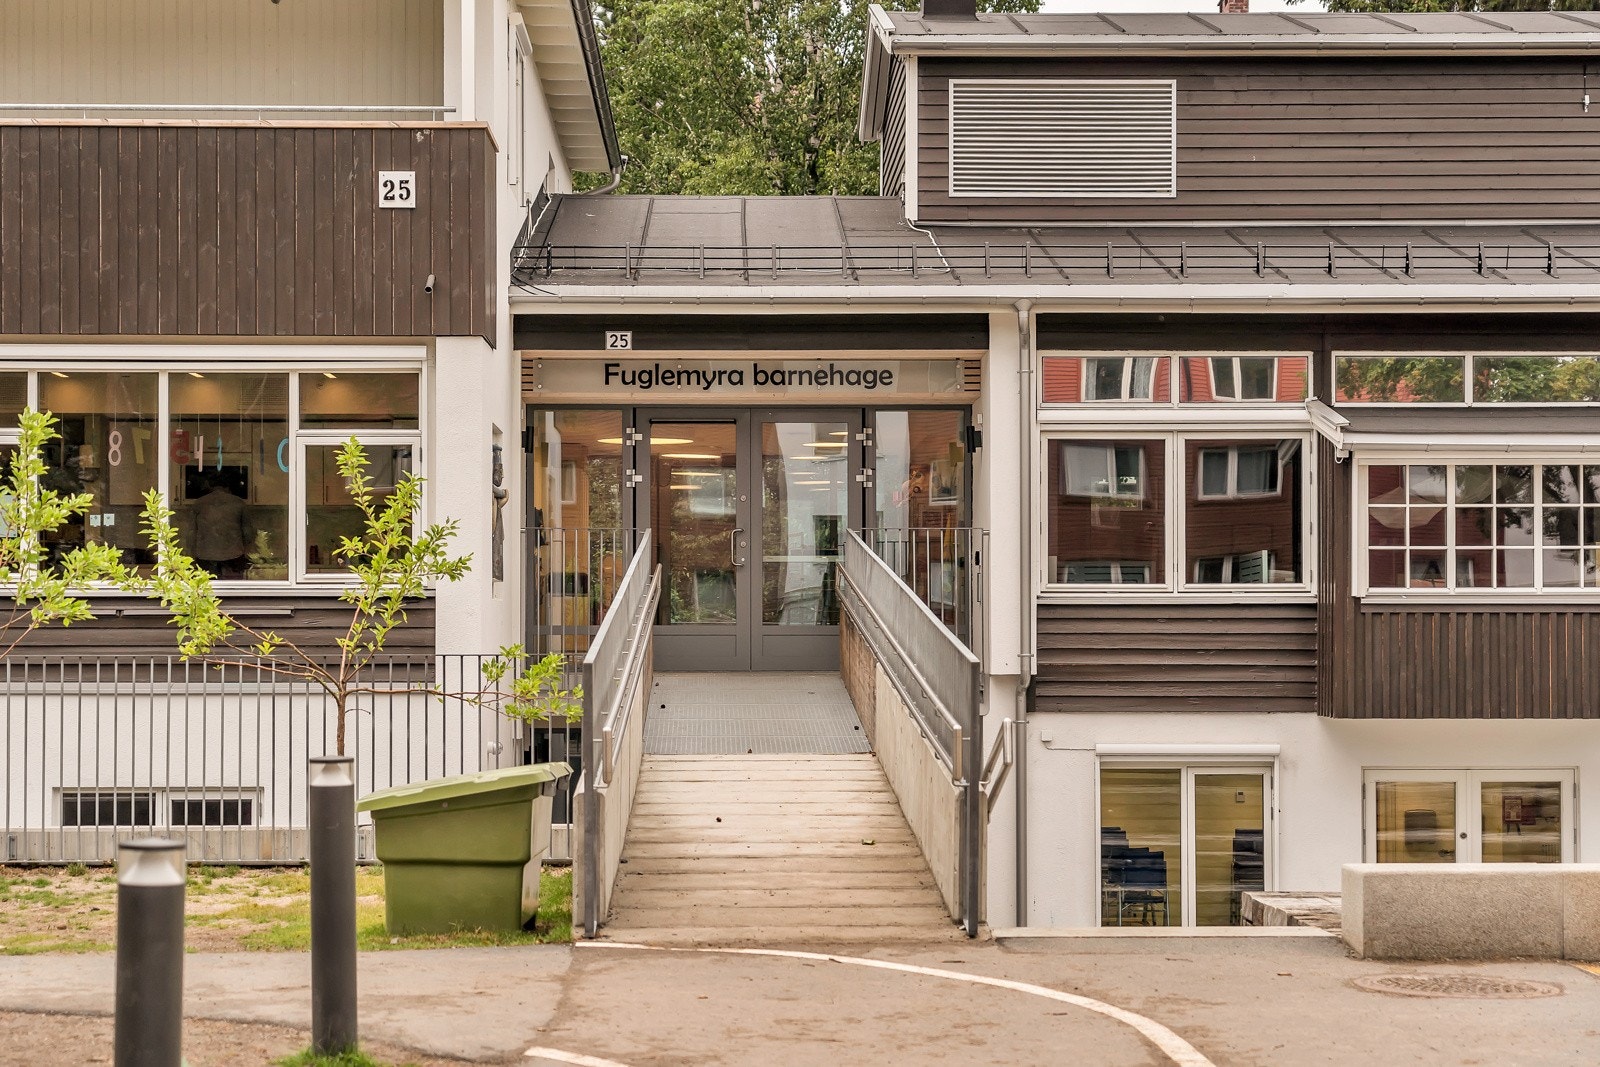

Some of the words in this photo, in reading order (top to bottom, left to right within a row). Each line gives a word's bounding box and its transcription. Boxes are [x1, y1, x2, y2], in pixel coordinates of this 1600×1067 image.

[382, 179, 411, 201] 25
[609, 334, 629, 348] 25
[604, 362, 744, 390] Fuglemyra
[753, 362, 894, 390] barnehage
